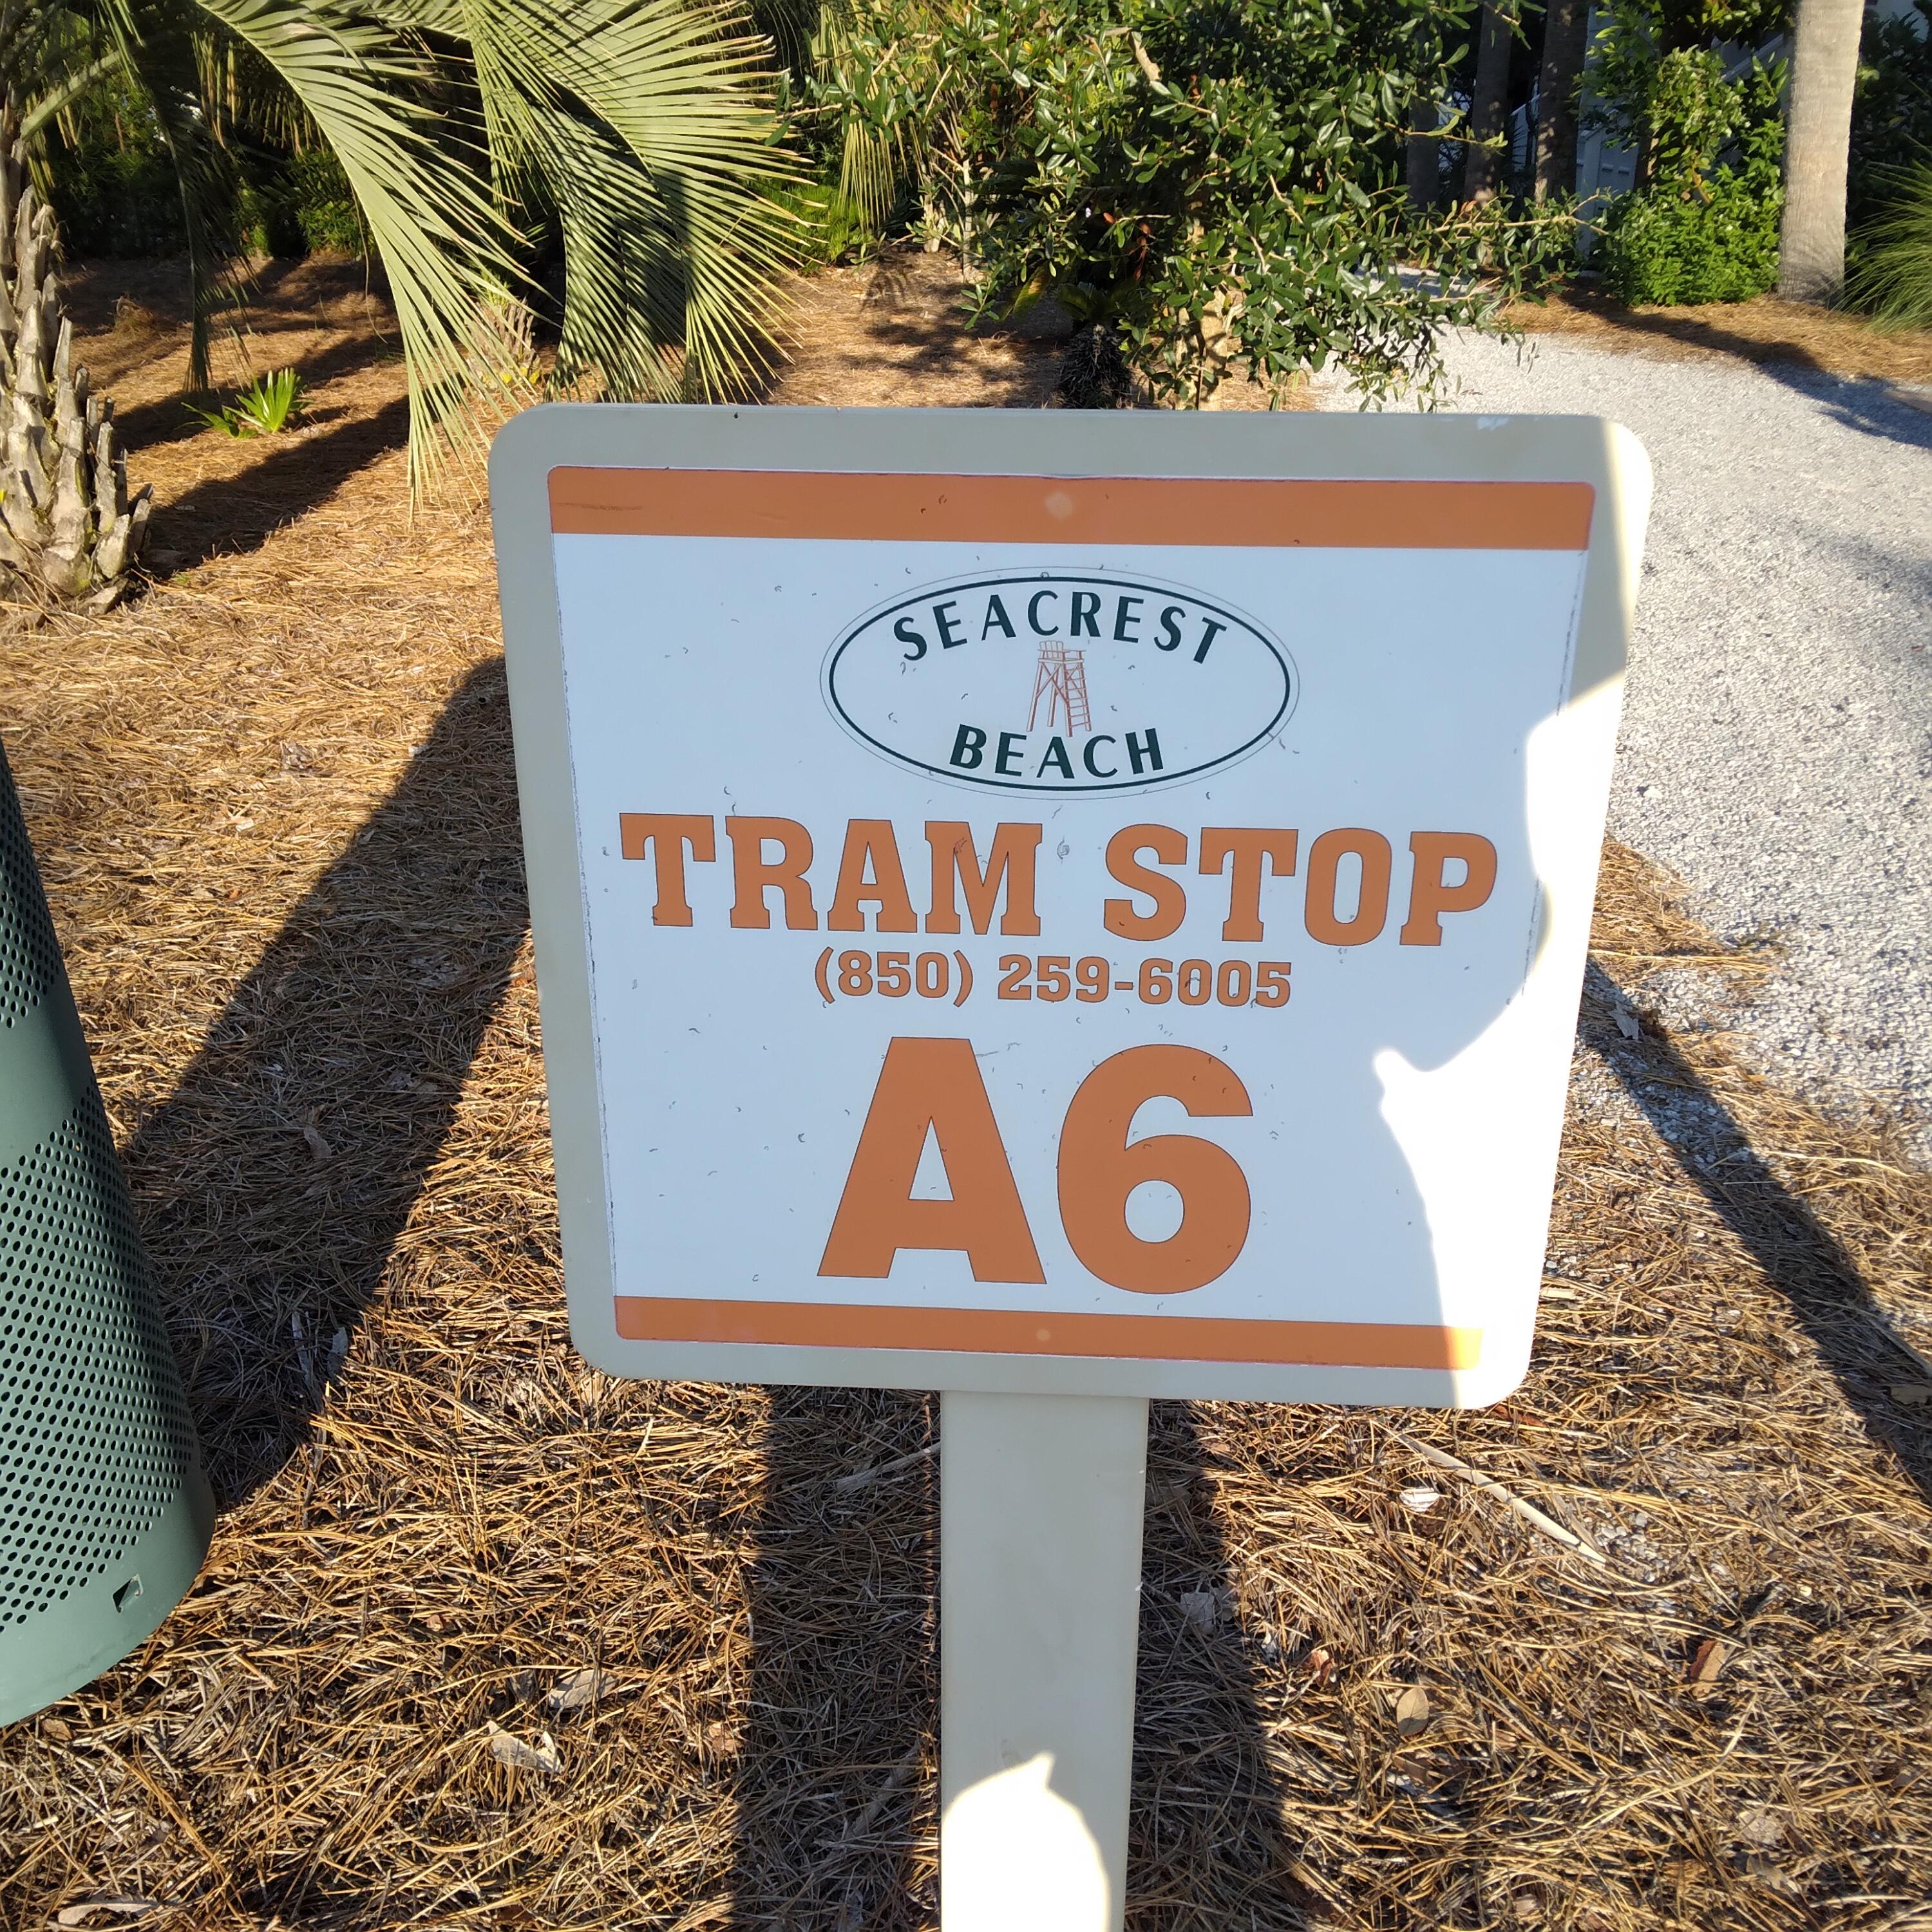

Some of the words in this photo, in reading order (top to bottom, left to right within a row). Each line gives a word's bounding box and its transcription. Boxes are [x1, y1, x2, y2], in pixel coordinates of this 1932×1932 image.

[893, 589, 1227, 665] SEACREST
[949, 723, 1164, 780] BEACH
[619, 813, 1044, 936] TRAM
[1104, 823, 1497, 947] STOP
[815, 946, 974, 1007] (850)
[998, 954, 1292, 1007] 259-6005
[817, 1037, 1253, 1294] A6
